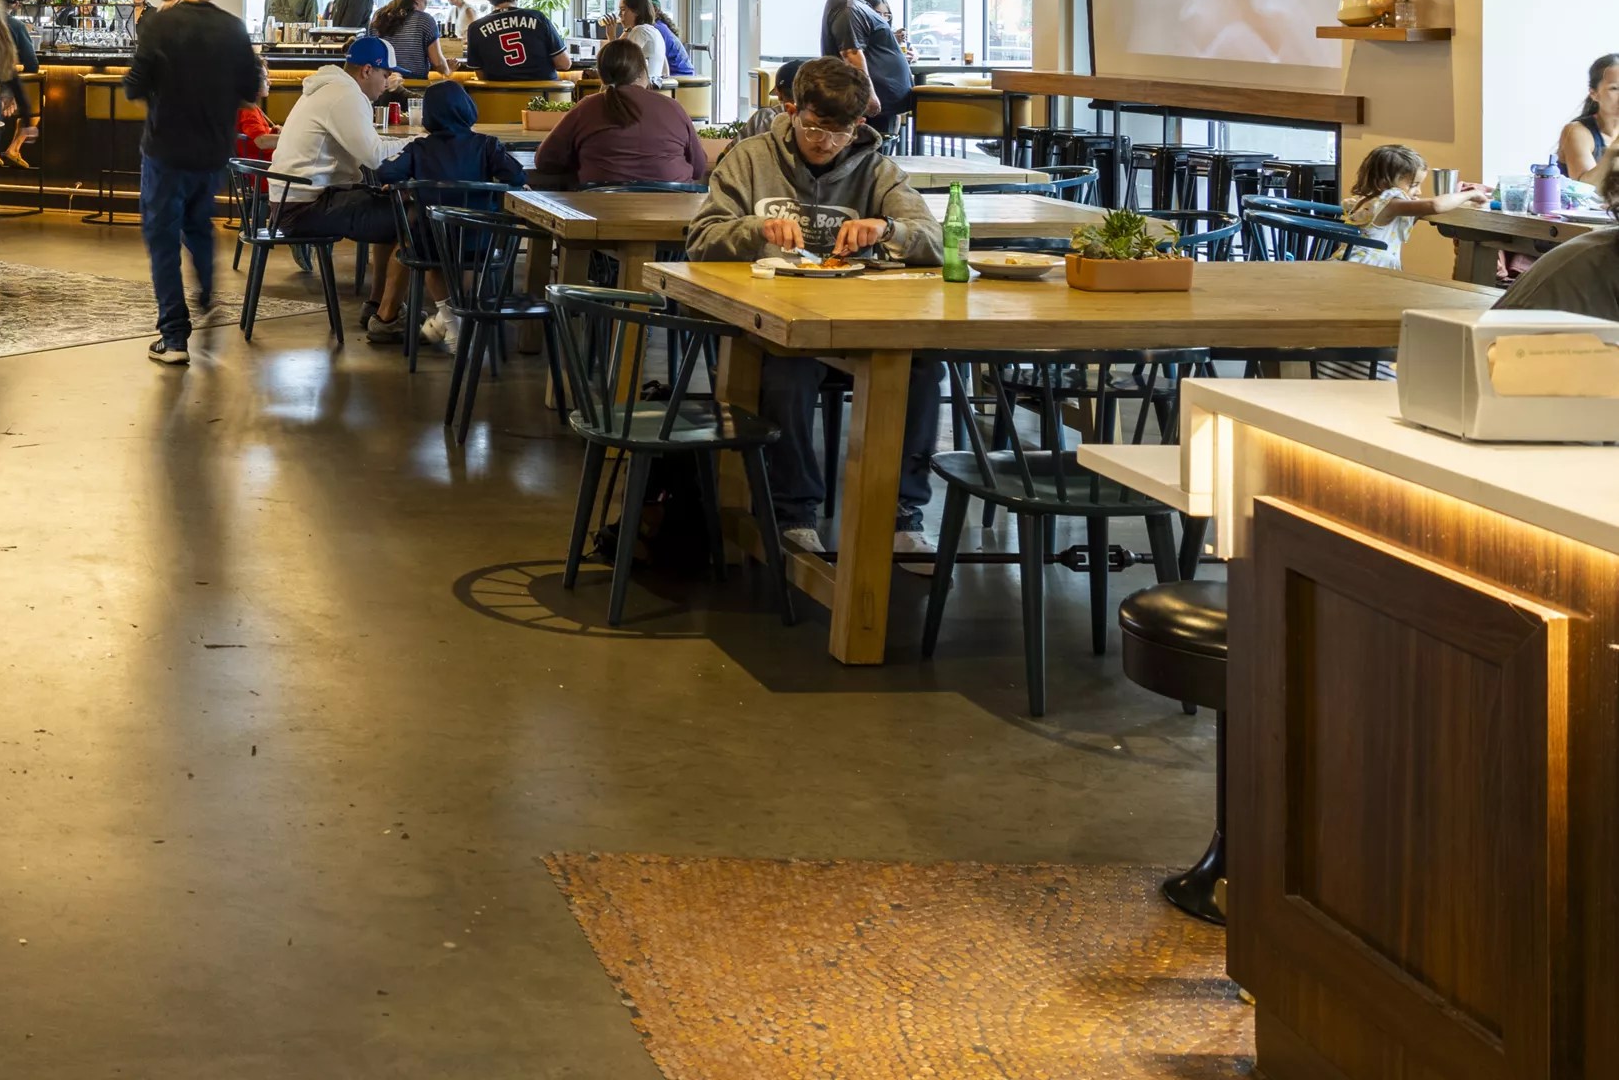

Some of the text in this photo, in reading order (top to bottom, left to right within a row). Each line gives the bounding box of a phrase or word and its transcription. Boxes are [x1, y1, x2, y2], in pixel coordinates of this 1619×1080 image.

[479, 16, 537, 38] FREEMAN
[499, 31, 527, 67] 5
[766, 204, 846, 228] Shoe Box
